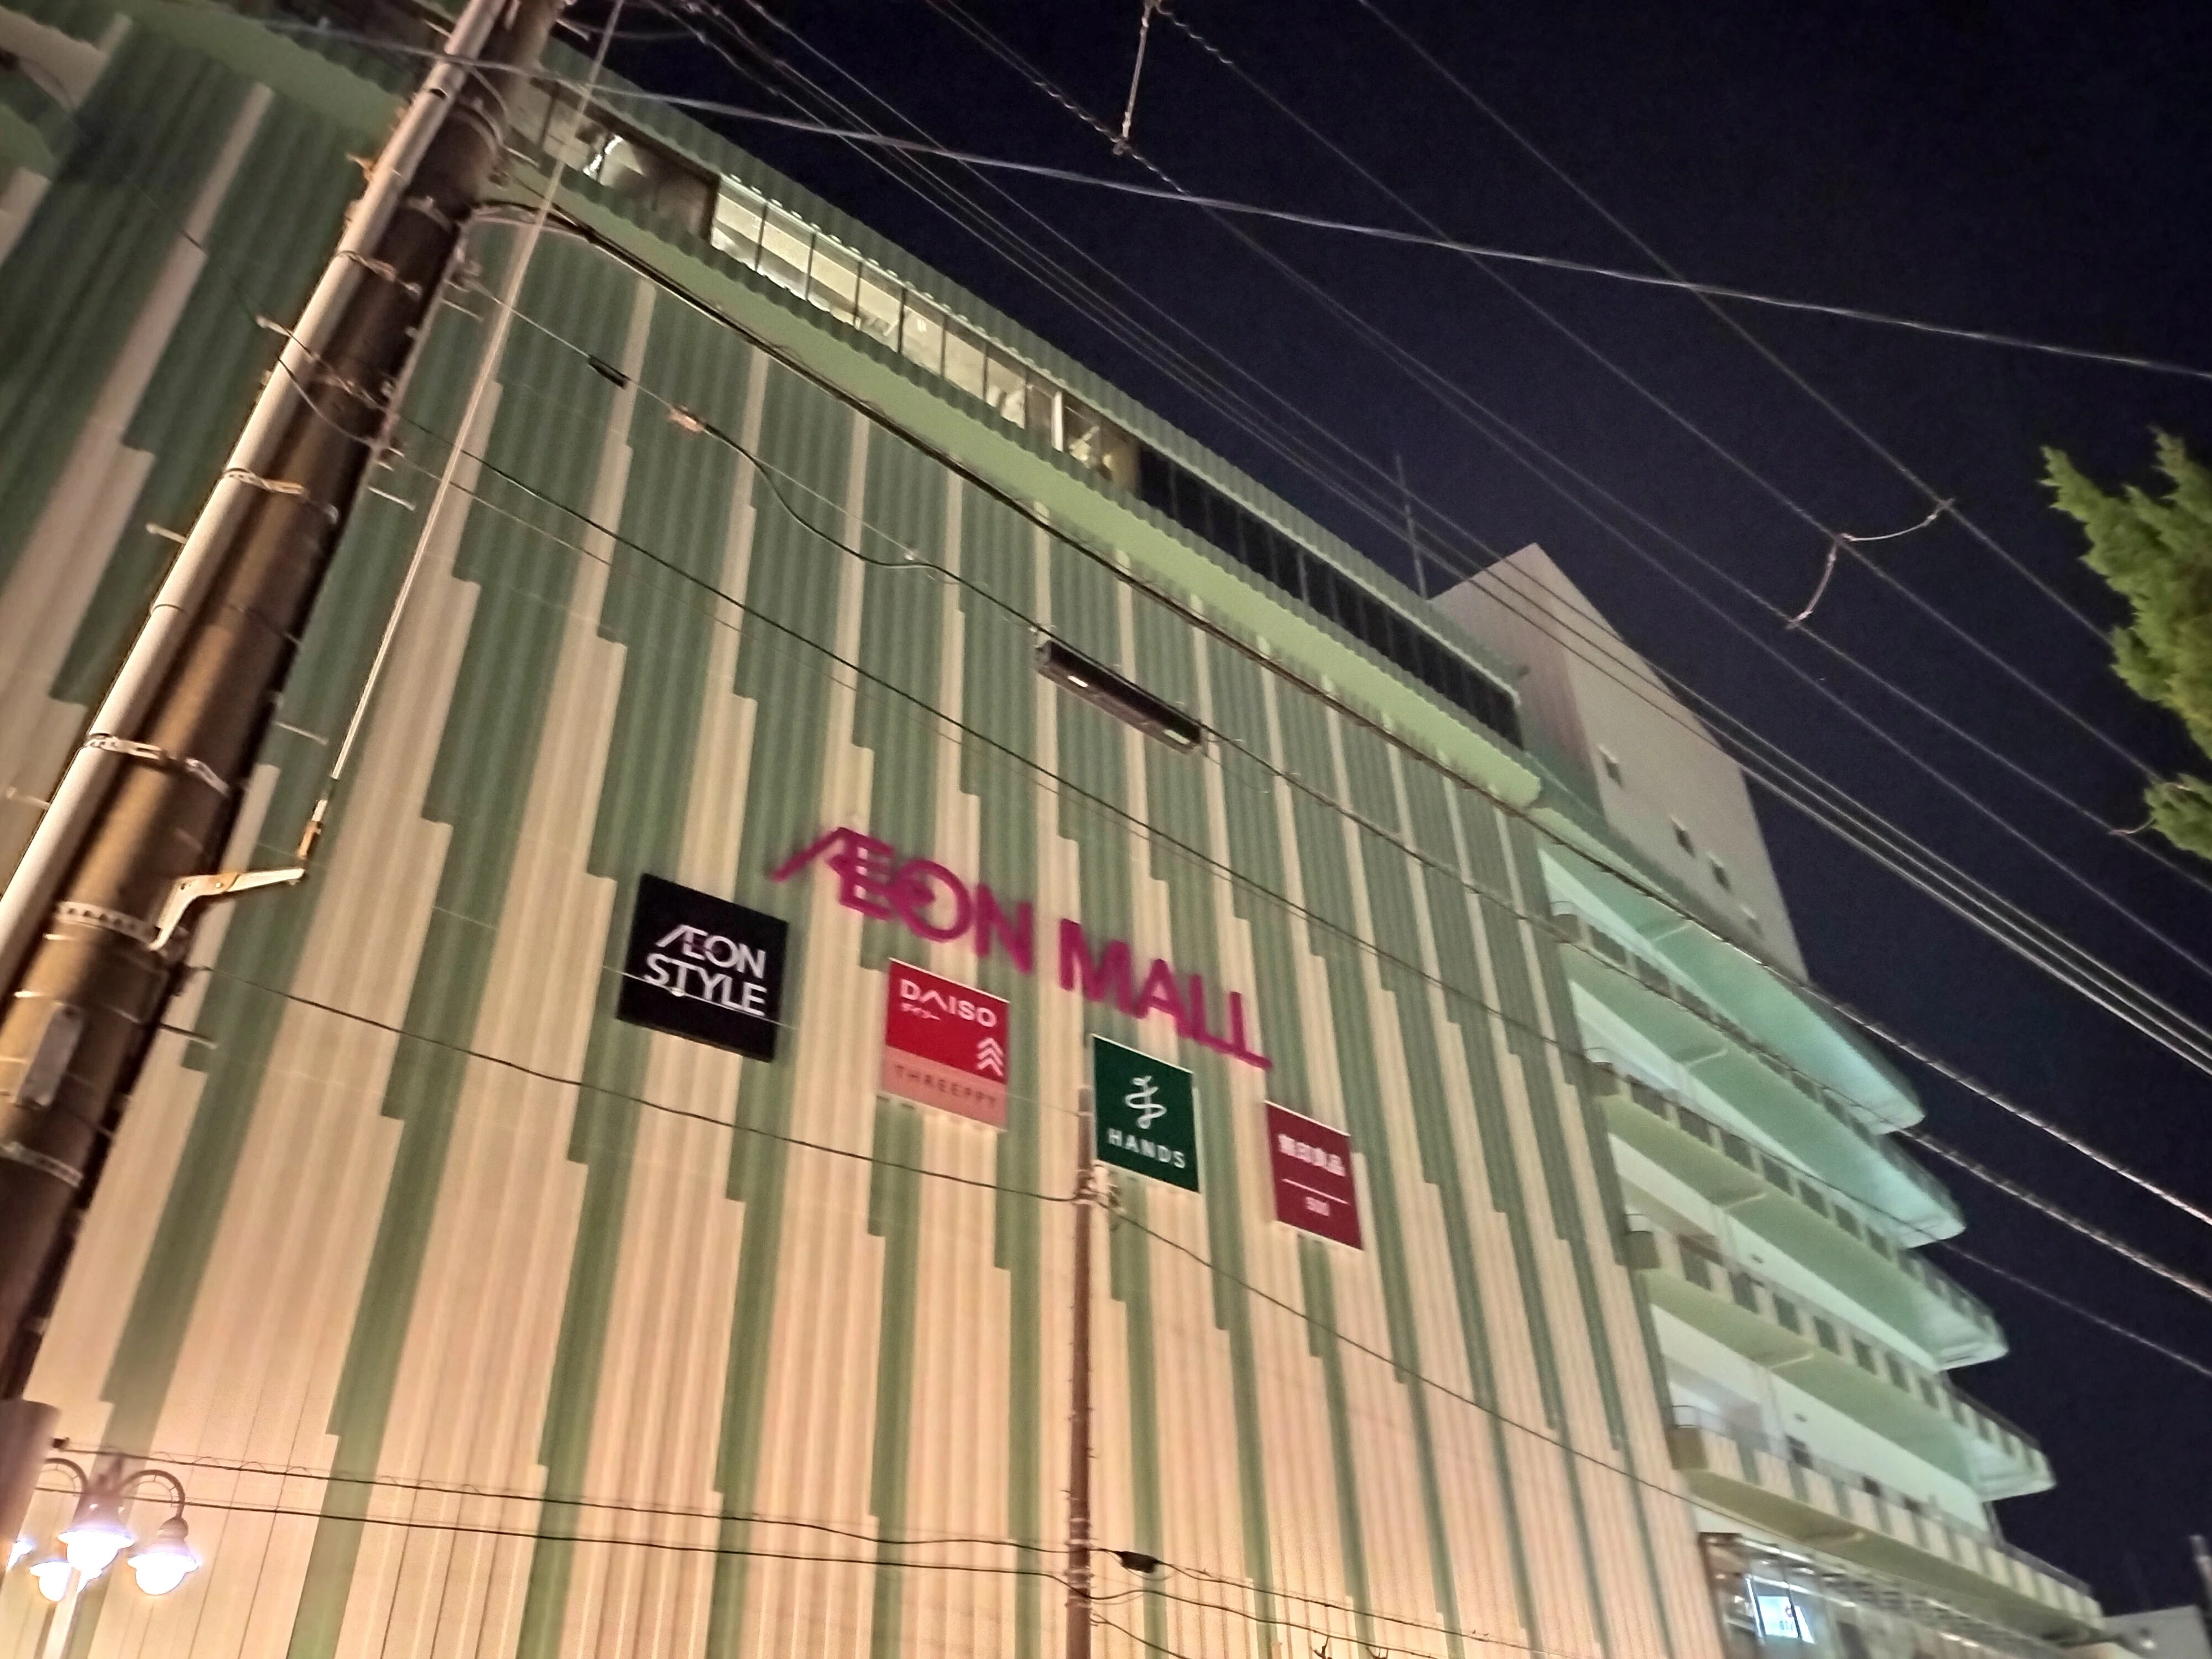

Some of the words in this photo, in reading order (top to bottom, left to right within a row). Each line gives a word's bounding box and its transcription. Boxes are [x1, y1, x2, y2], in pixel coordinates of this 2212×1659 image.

[644, 953, 768, 1017] STYLE
[900, 978, 998, 1027] DAISO
[1060, 917, 1273, 1071] MALL
[1108, 1128, 1186, 1168] HANDS
